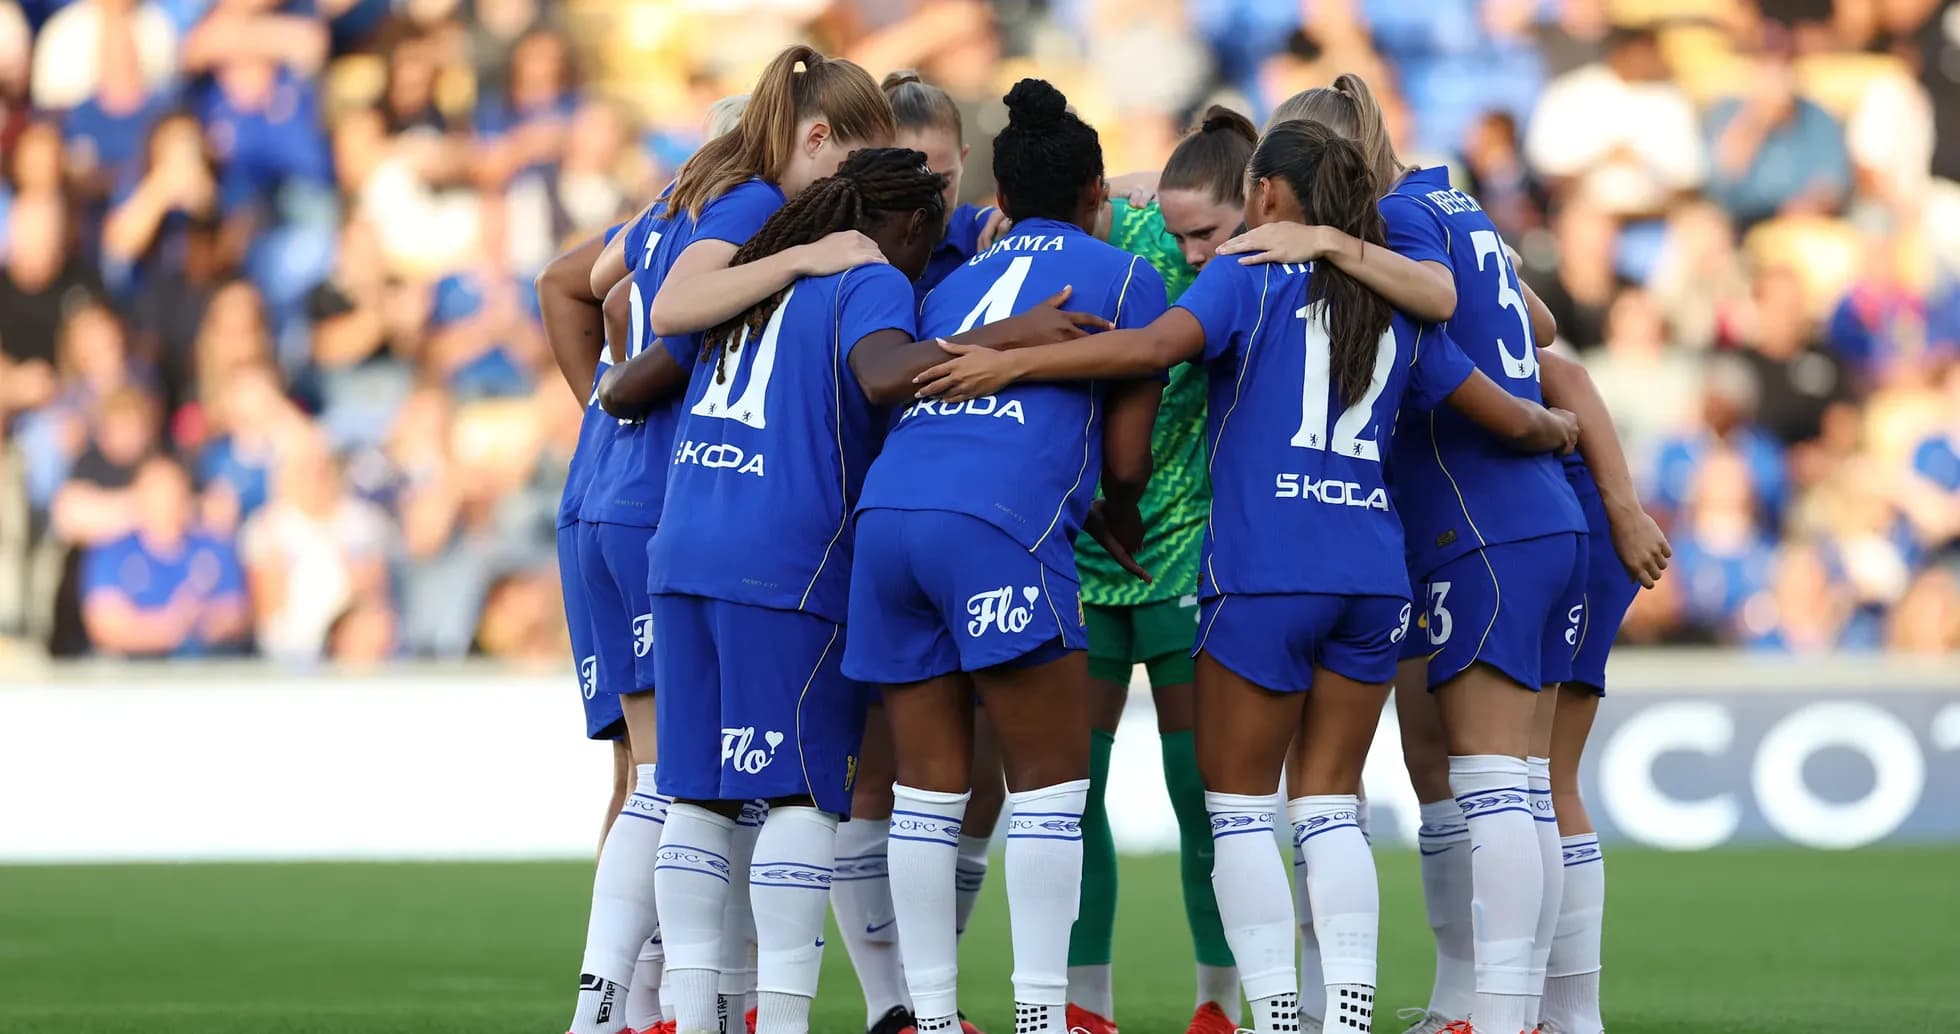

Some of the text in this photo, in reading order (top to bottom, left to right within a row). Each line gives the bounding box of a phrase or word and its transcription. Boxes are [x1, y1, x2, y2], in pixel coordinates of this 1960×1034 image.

[1470, 230, 1541, 384] 3
[1290, 298, 1397, 462] 12
[967, 585, 1033, 637] Flo
[721, 726, 773, 775] Flo
[1598, 697, 1960, 850] CO
[899, 819, 937, 833] CFC
[661, 851, 701, 863] CFC
